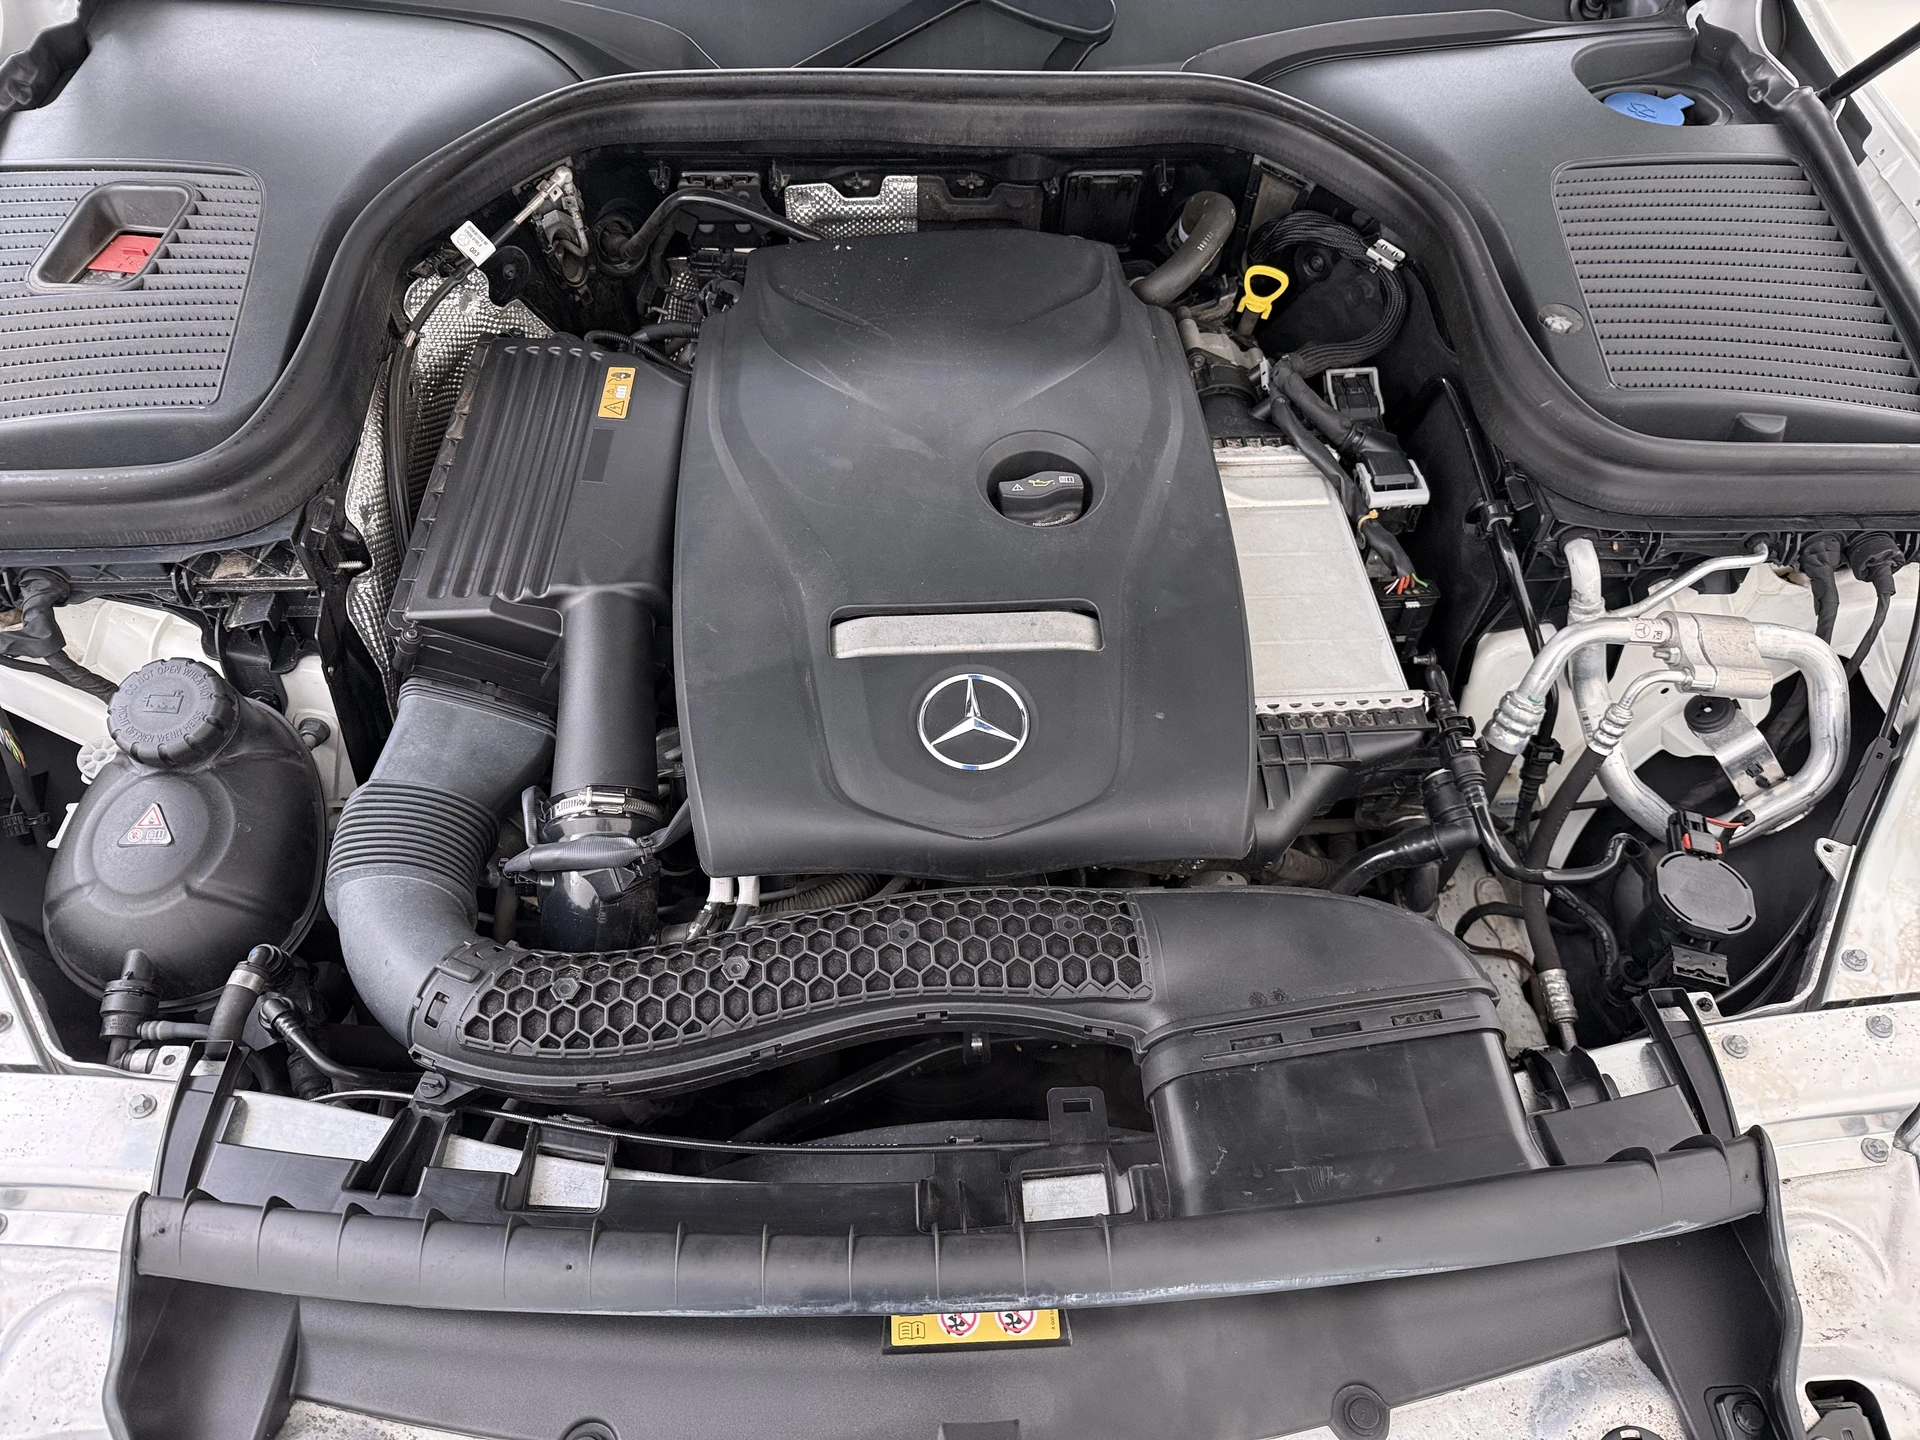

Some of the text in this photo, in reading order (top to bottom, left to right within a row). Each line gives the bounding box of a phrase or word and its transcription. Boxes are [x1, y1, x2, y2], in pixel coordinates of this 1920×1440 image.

[125, 665, 212, 701] DO NOT OPEN WHEN HOT
[118, 704, 131, 728] NICHT
[156, 728, 183, 743] WENN
[184, 710, 204, 731] HEISS
